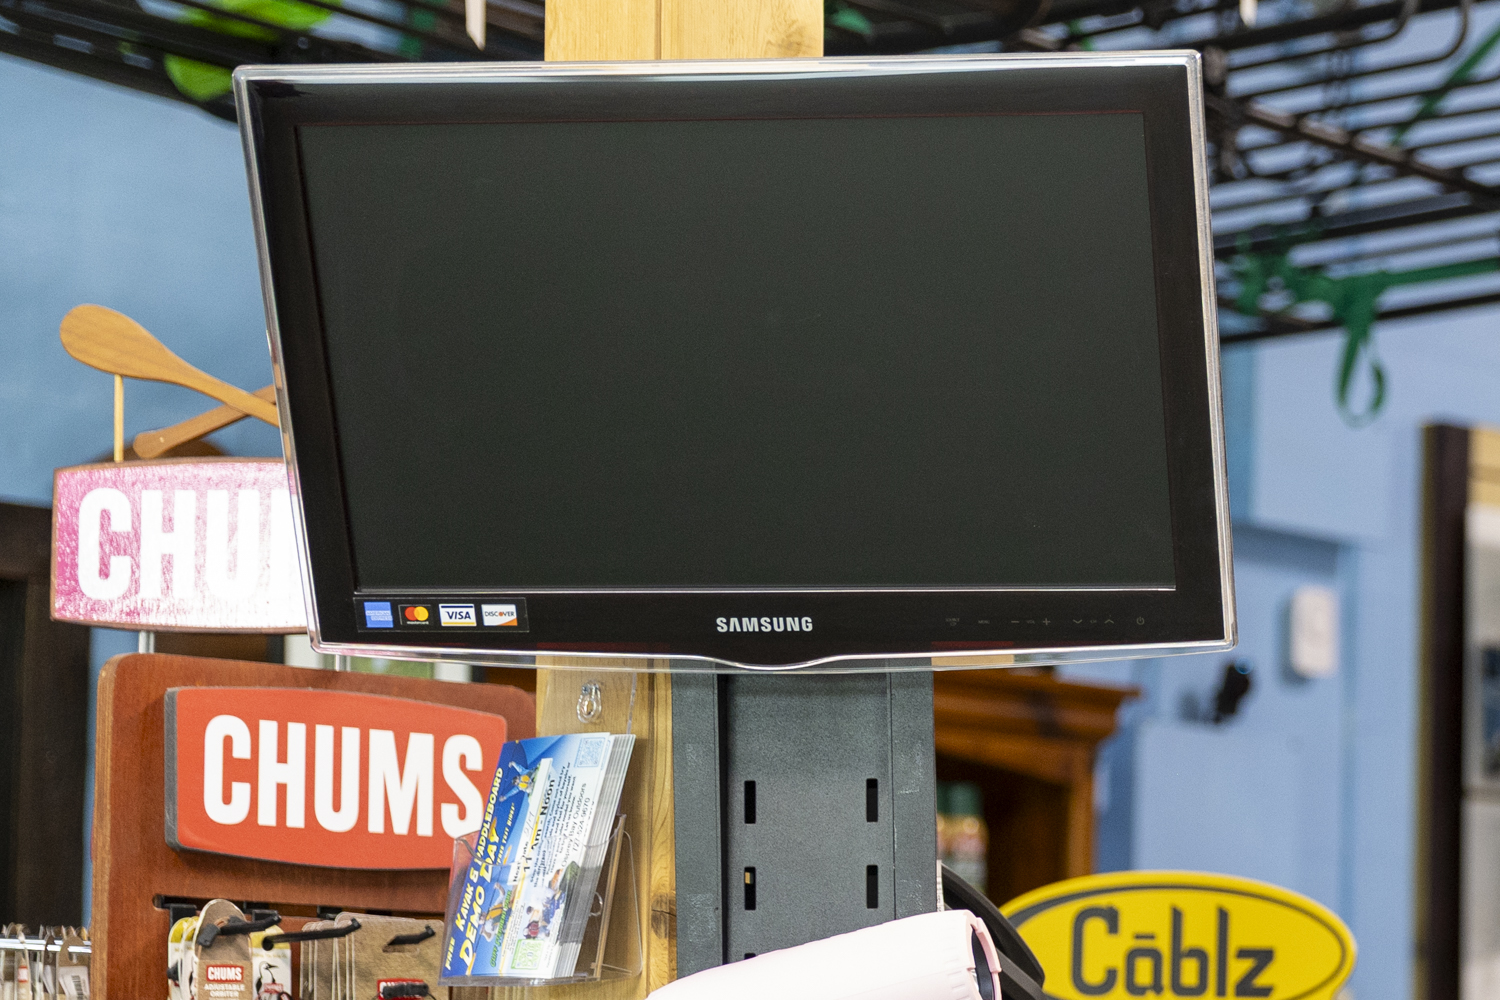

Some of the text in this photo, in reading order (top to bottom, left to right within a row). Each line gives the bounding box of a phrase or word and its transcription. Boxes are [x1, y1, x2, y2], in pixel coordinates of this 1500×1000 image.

[77, 487, 300, 601] CHU
[446, 611, 471, 620] VISA
[716, 617, 813, 633] SAMSUNG
[203, 714, 485, 840] CHUMS
[207, 966, 242, 981] CHUMS
